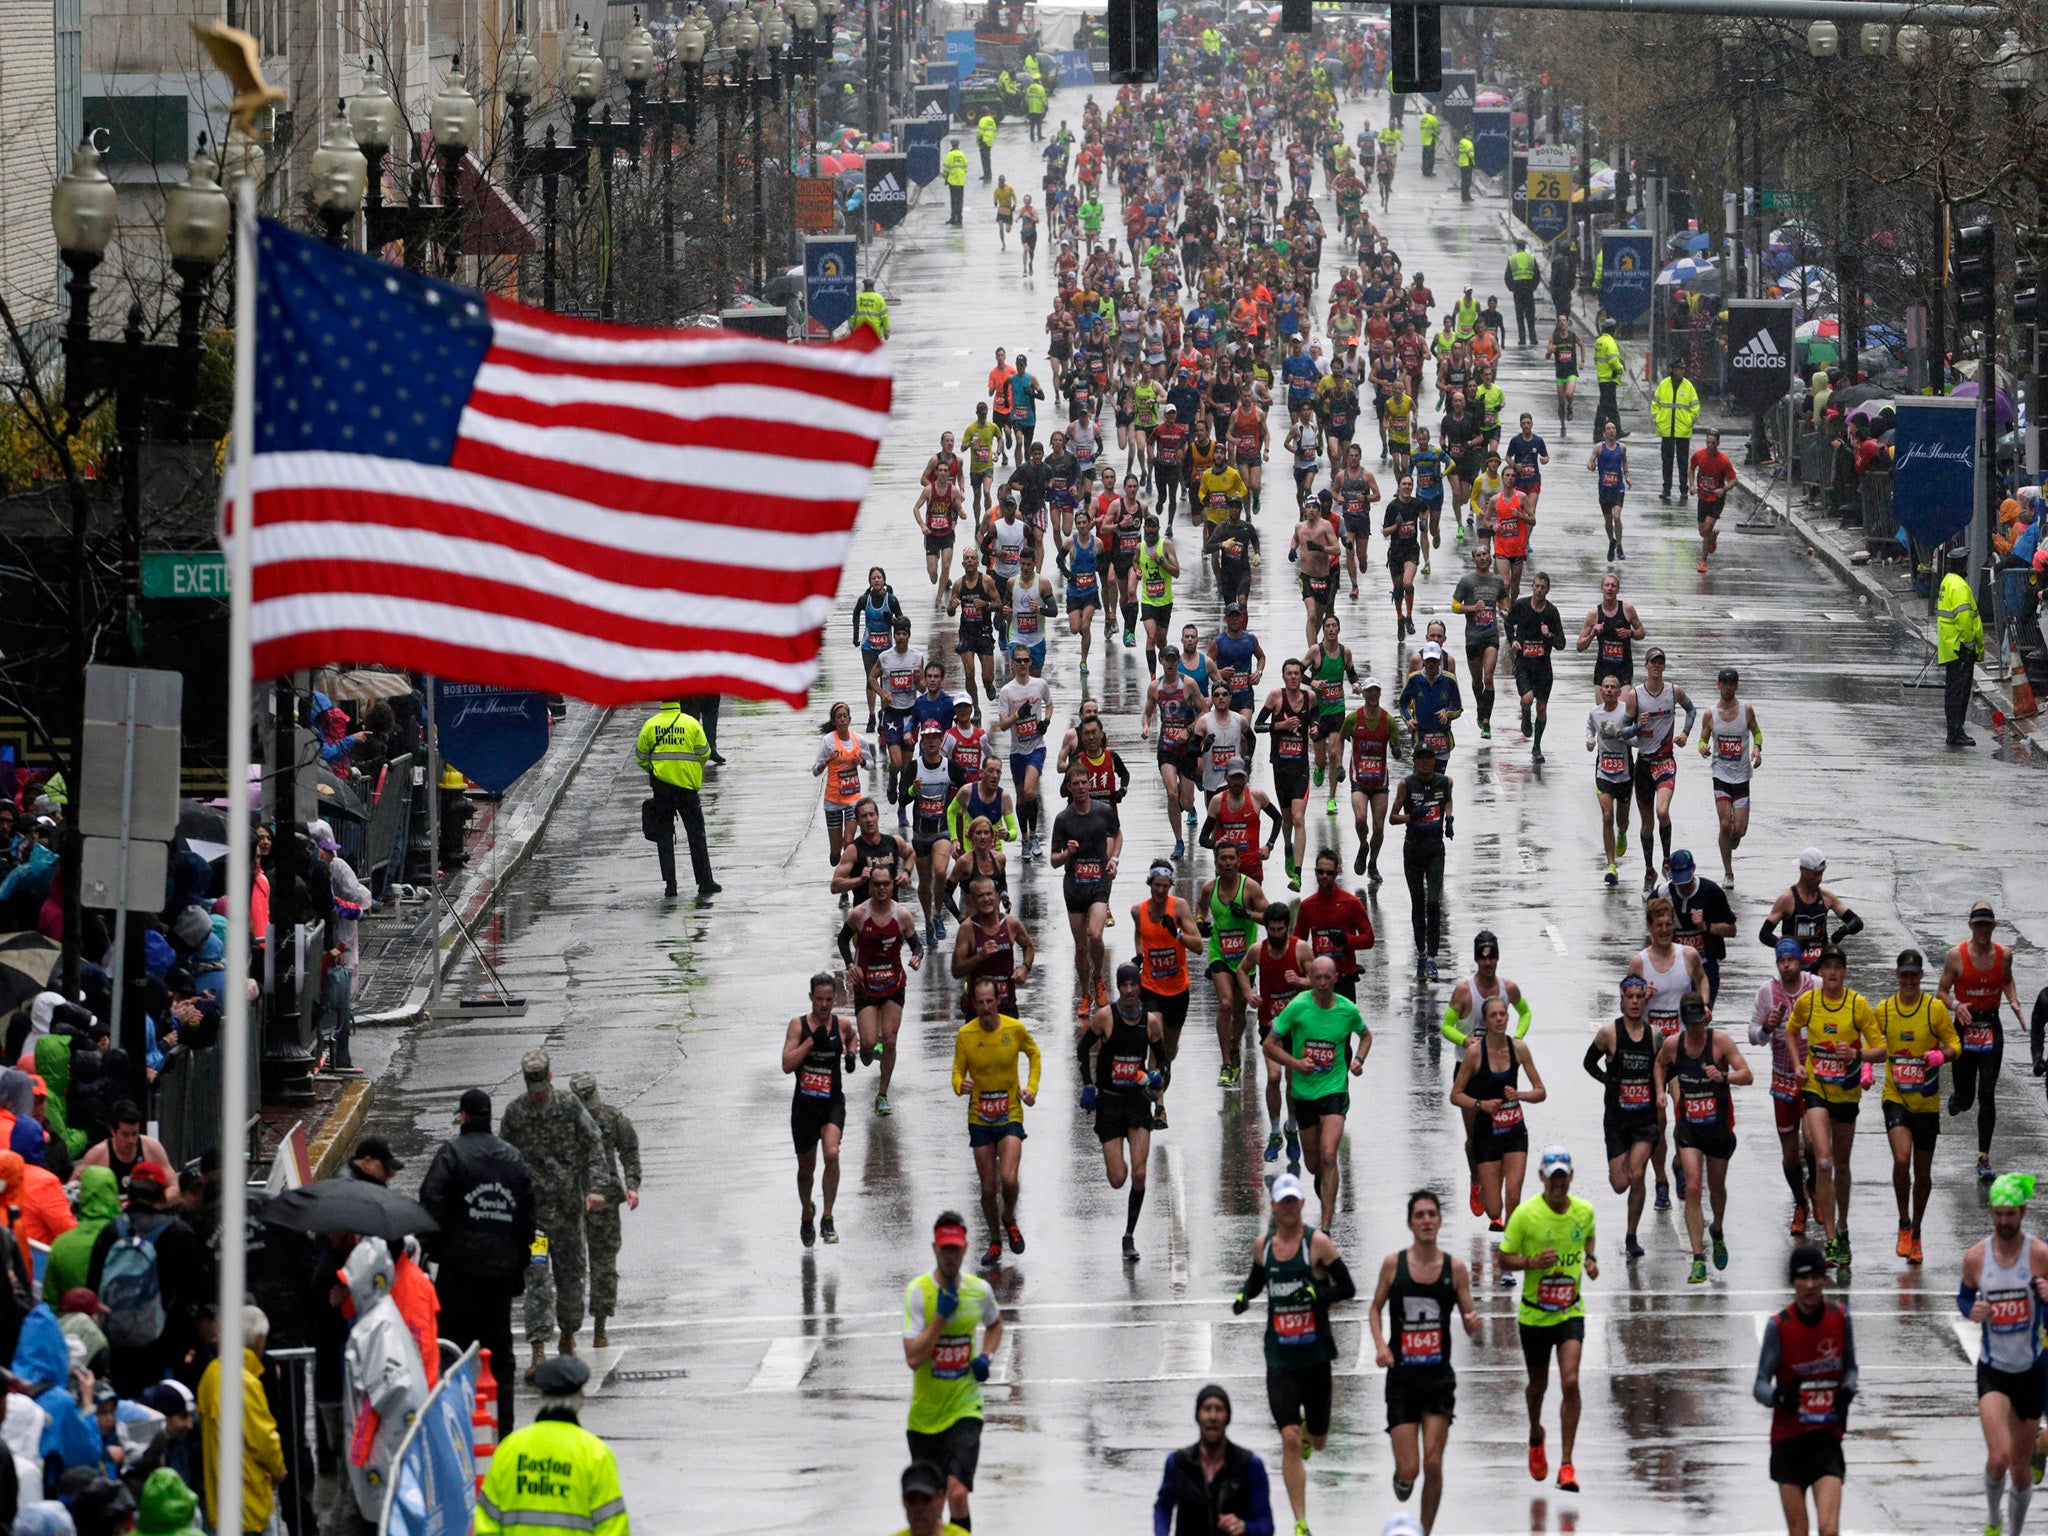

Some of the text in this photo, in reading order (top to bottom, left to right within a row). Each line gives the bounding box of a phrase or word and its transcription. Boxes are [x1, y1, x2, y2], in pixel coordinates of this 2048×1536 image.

[868, 191, 906, 202] adidas
[1536, 180, 1561, 199] 26
[1733, 353, 1787, 368] adidas
[442, 685, 481, 695] BOSTON
[655, 725, 685, 735] Boston
[656, 735, 685, 745] Police
[1077, 863, 1100, 873] 2970
[1306, 1049, 1334, 1062] 2569
[1814, 1057, 1844, 1071] 4780
[1621, 1085, 1649, 1098] 3026
[1686, 1098, 1715, 1113] 2516
[1277, 1312, 1310, 1328] 1597
[1405, 1331, 1439, 1348] 1643
[517, 1453, 572, 1476] Boston
[517, 1474, 570, 1499] Police
